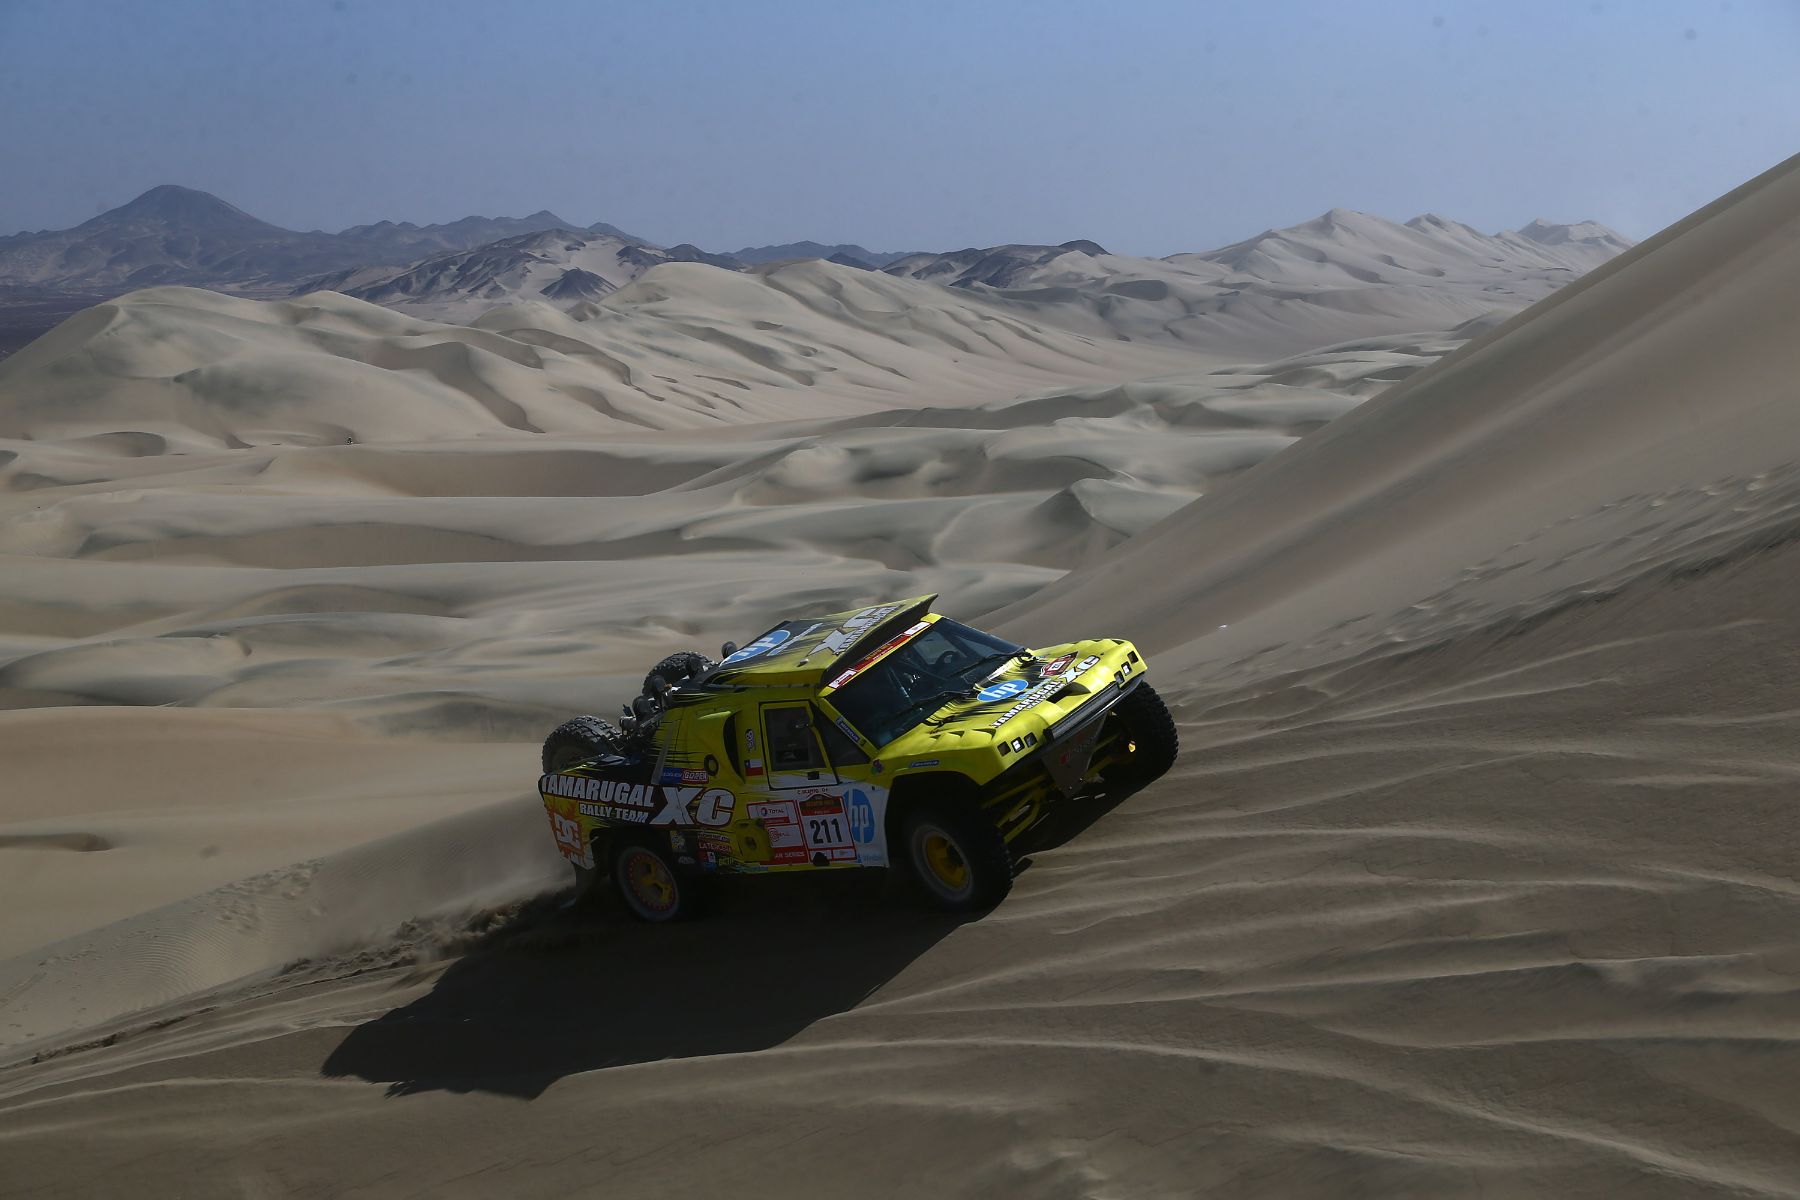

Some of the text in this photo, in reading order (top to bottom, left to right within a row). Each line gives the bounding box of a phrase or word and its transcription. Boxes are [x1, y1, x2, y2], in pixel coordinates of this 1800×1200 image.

[1059, 655, 1100, 684] XC
[981, 682, 1020, 699] hp
[991, 680, 1061, 728] TAMARUGAL
[541, 774, 734, 826] TAMARUGAL XC
[579, 803, 649, 823] RALLY TEAM
[848, 788, 870, 844] hp
[810, 818, 842, 844] 211
